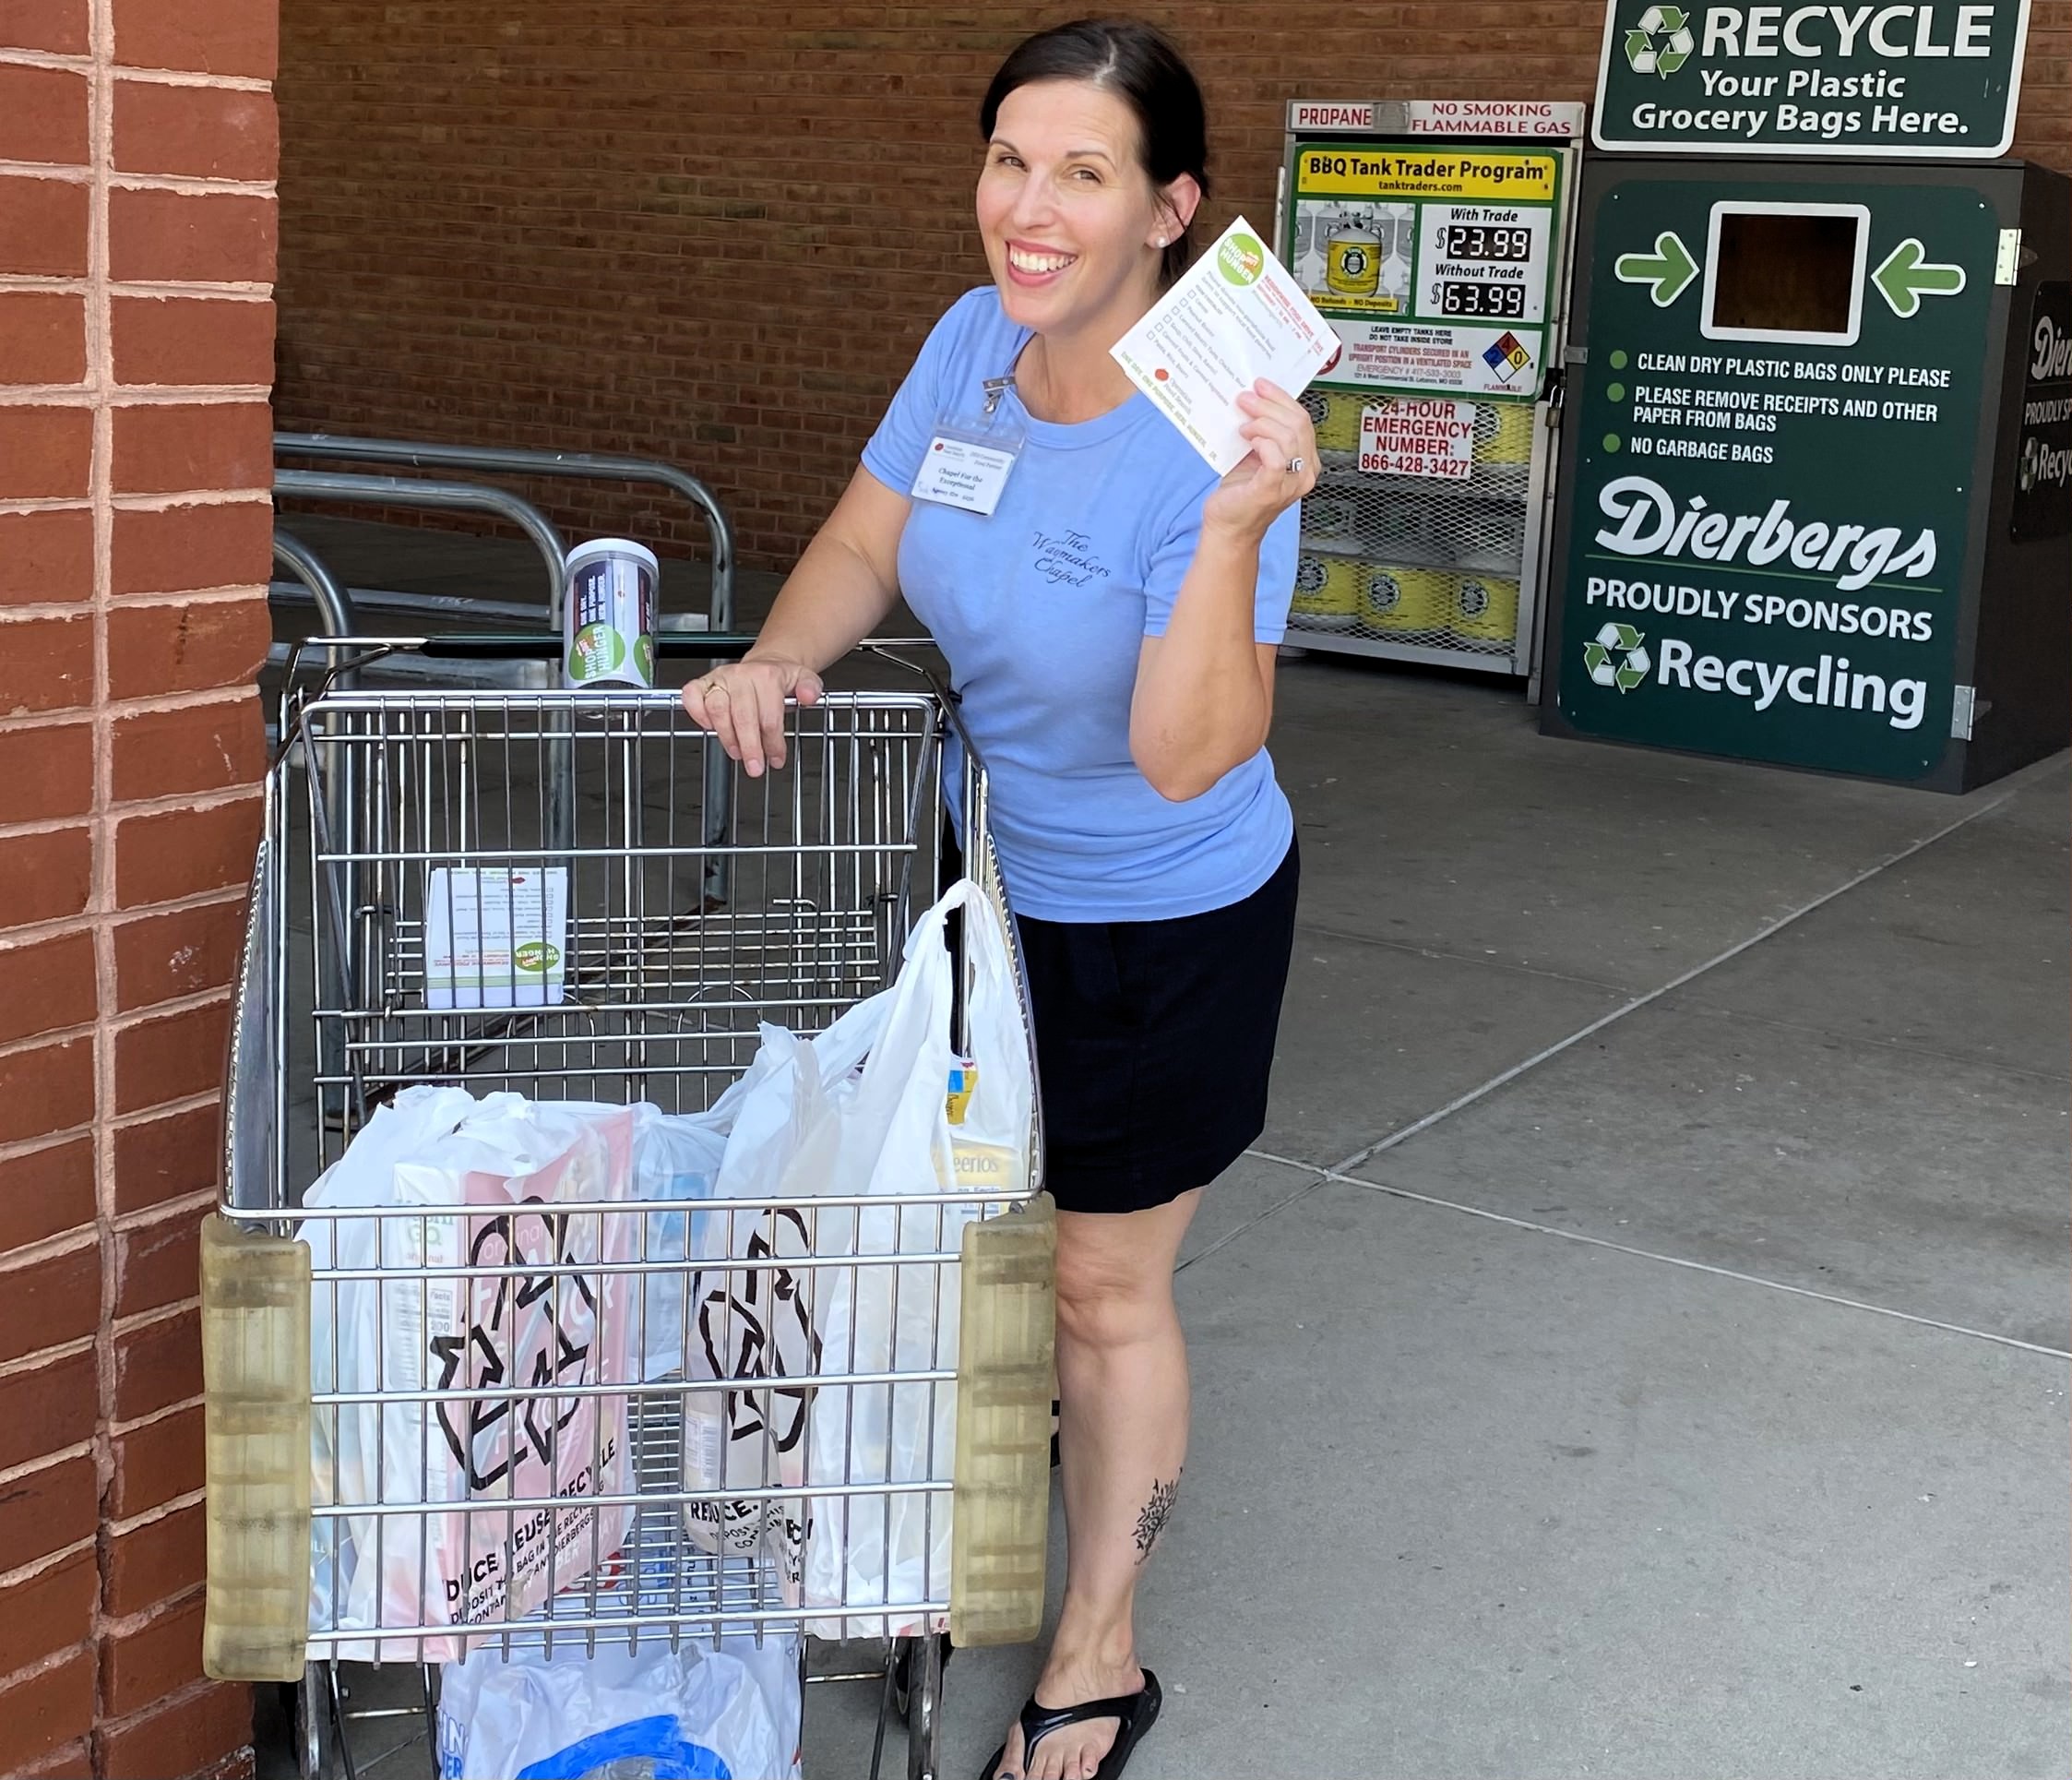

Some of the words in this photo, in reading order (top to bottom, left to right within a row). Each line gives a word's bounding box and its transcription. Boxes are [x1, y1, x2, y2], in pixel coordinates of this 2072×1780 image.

[1701, 3, 1995, 58] RECYCLE
[1701, 69, 1778, 98] Your
[1787, 70, 1906, 99] Plastic
[1299, 108, 1372, 126] PROPANE
[1433, 103, 1458, 116] NO
[1462, 104, 1552, 117] SMOKING
[1632, 102, 1768, 137] Grocery
[1776, 104, 1862, 138] Bags
[1871, 105, 1969, 135] Here.
[1412, 120, 1528, 134] FLAMMABLE
[1534, 121, 1571, 135] GAS
[1309, 157, 1347, 177] BBQ
[1351, 159, 1392, 176] Tank
[1396, 160, 1456, 178] Trader
[1459, 161, 1543, 183] Program
[1378, 181, 1463, 193] tanktraders.com
[1450, 208, 1479, 221] With
[1483, 209, 1518, 222] Trade
[1223, 237, 1246, 264] SHOP
[1220, 248, 1255, 284] HUNGER
[1435, 264, 1485, 278] Without
[1488, 266, 1524, 280] Trade
[1433, 337, 1453, 345] STORE
[1435, 329, 1452, 338] HERE
[1501, 336, 1510, 350] 4
[1349, 353, 1373, 362] UPRIGHT
[1375, 354, 1401, 364] POSITION
[1416, 358, 1452, 367] VENTILATED
[1453, 359, 1471, 368] SPACE
[1353, 343, 1387, 353] TRANSPORT
[1388, 346, 1421, 355] CYLINDERS
[1423, 348, 1450, 357] SECURED
[1459, 351, 1469, 359] AN
[1489, 350, 1499, 364] 2
[1514, 351, 1522, 364] 0
[1357, 364, 1404, 374] EMERGENCY
[1637, 352, 1685, 373] CLEAN
[1690, 356, 1722, 374] DRY
[1726, 358, 1790, 378] PLASTIC
[1793, 362, 1837, 381] BAGS
[1841, 364, 1884, 384] ONLY
[1887, 368, 1951, 388] PLEASE
[1483, 383, 1523, 392] FLAMMBLE
[1381, 401, 1456, 419] 24-HOUR
[1635, 386, 1691, 406] PLEASE
[1695, 389, 1759, 411] REMOVE
[1764, 394, 1839, 415] RECEIPTS
[1842, 399, 1877, 419] AND
[1883, 401, 1938, 423] OTHER
[2025, 399, 2063, 425] PROUDLY
[1363, 416, 1472, 438] EMERGENCY
[1633, 406, 1681, 425] PAPER
[1685, 409, 1731, 429] FROM
[1734, 412, 1777, 432] BAGS
[1375, 436, 1455, 457] NUMBER:
[1630, 436, 1652, 454] NO
[1656, 439, 1728, 460] GARBAGE
[1732, 444, 1773, 464] BAGS
[1362, 453, 1469, 476] 866-428-3427
[1062, 530, 1091, 552] The
[1594, 475, 1937, 591] Dierbergs
[1034, 557, 1093, 588] Chapel
[1586, 577, 1739, 620] PROUDLY
[1744, 593, 1933, 641] SPONSORS
[592, 625, 612, 672] HUNGER
[585, 648, 597, 679] SHOP
[1658, 639, 1927, 731] Recycling
[953, 1155, 999, 1174] eerios
[517, 1549, 535, 1573] BAG
